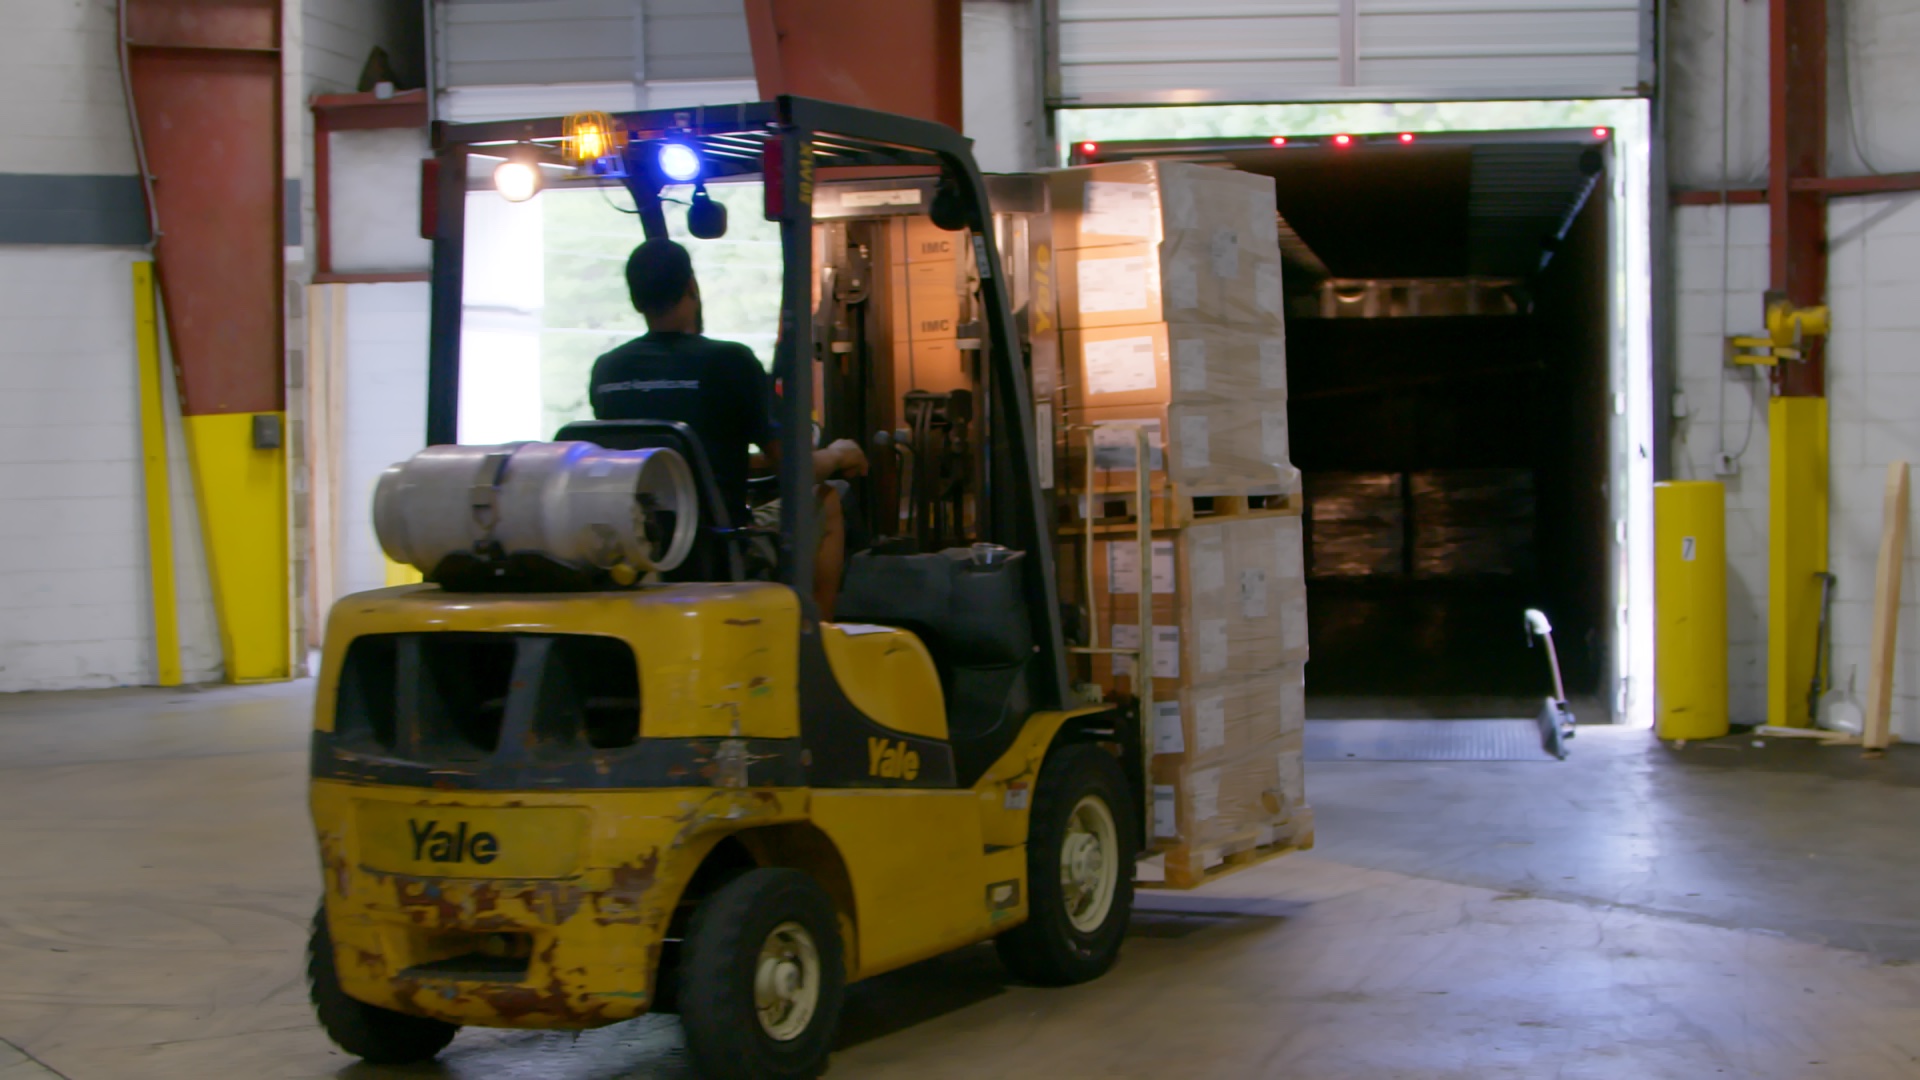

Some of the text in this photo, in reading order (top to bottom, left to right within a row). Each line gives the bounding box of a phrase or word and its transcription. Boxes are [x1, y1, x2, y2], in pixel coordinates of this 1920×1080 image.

[921, 241, 950, 254] IMC
[921, 319, 949, 333] IMC
[1683, 538, 1694, 559] 7
[867, 736, 919, 781] Yale
[408, 818, 498, 865] Yale
